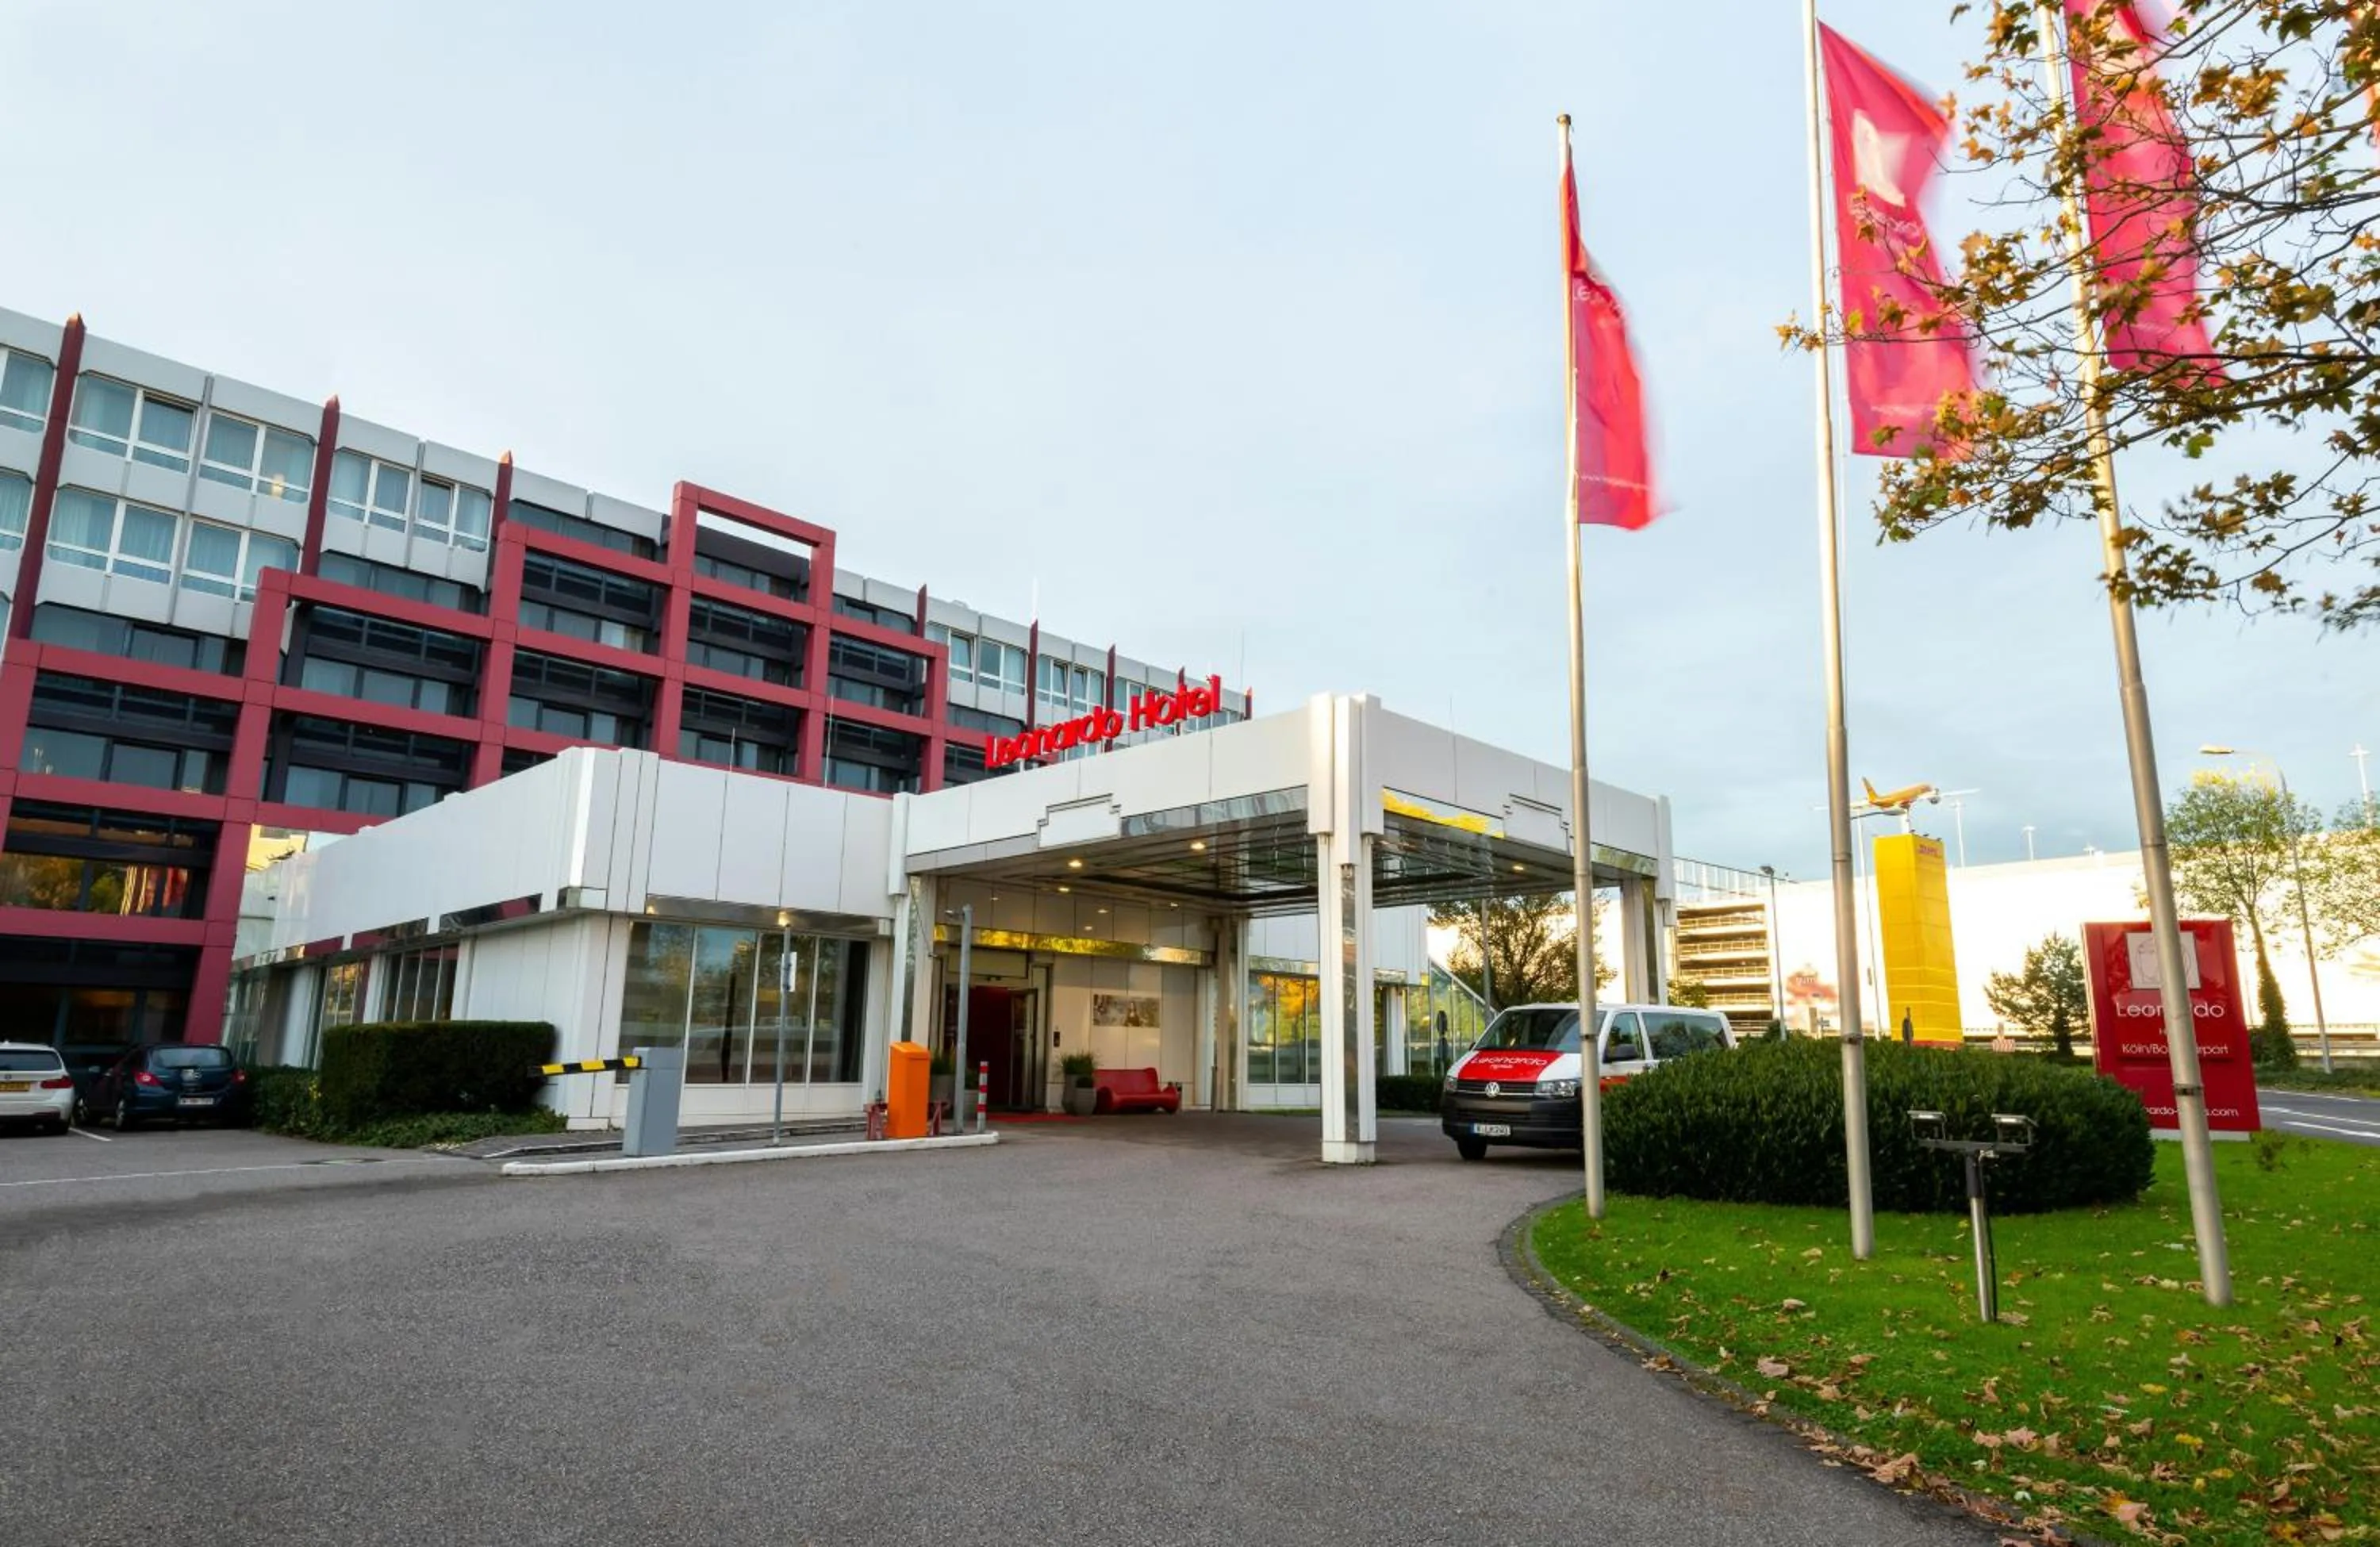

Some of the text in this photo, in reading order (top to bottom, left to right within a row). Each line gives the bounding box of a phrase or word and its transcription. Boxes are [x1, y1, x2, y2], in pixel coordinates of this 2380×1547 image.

[985, 674, 1222, 769] Leonardo Hotel
[2116, 1002, 2225, 1017] Leodo
[2121, 1042, 2228, 1057] Köln/Bo rport
